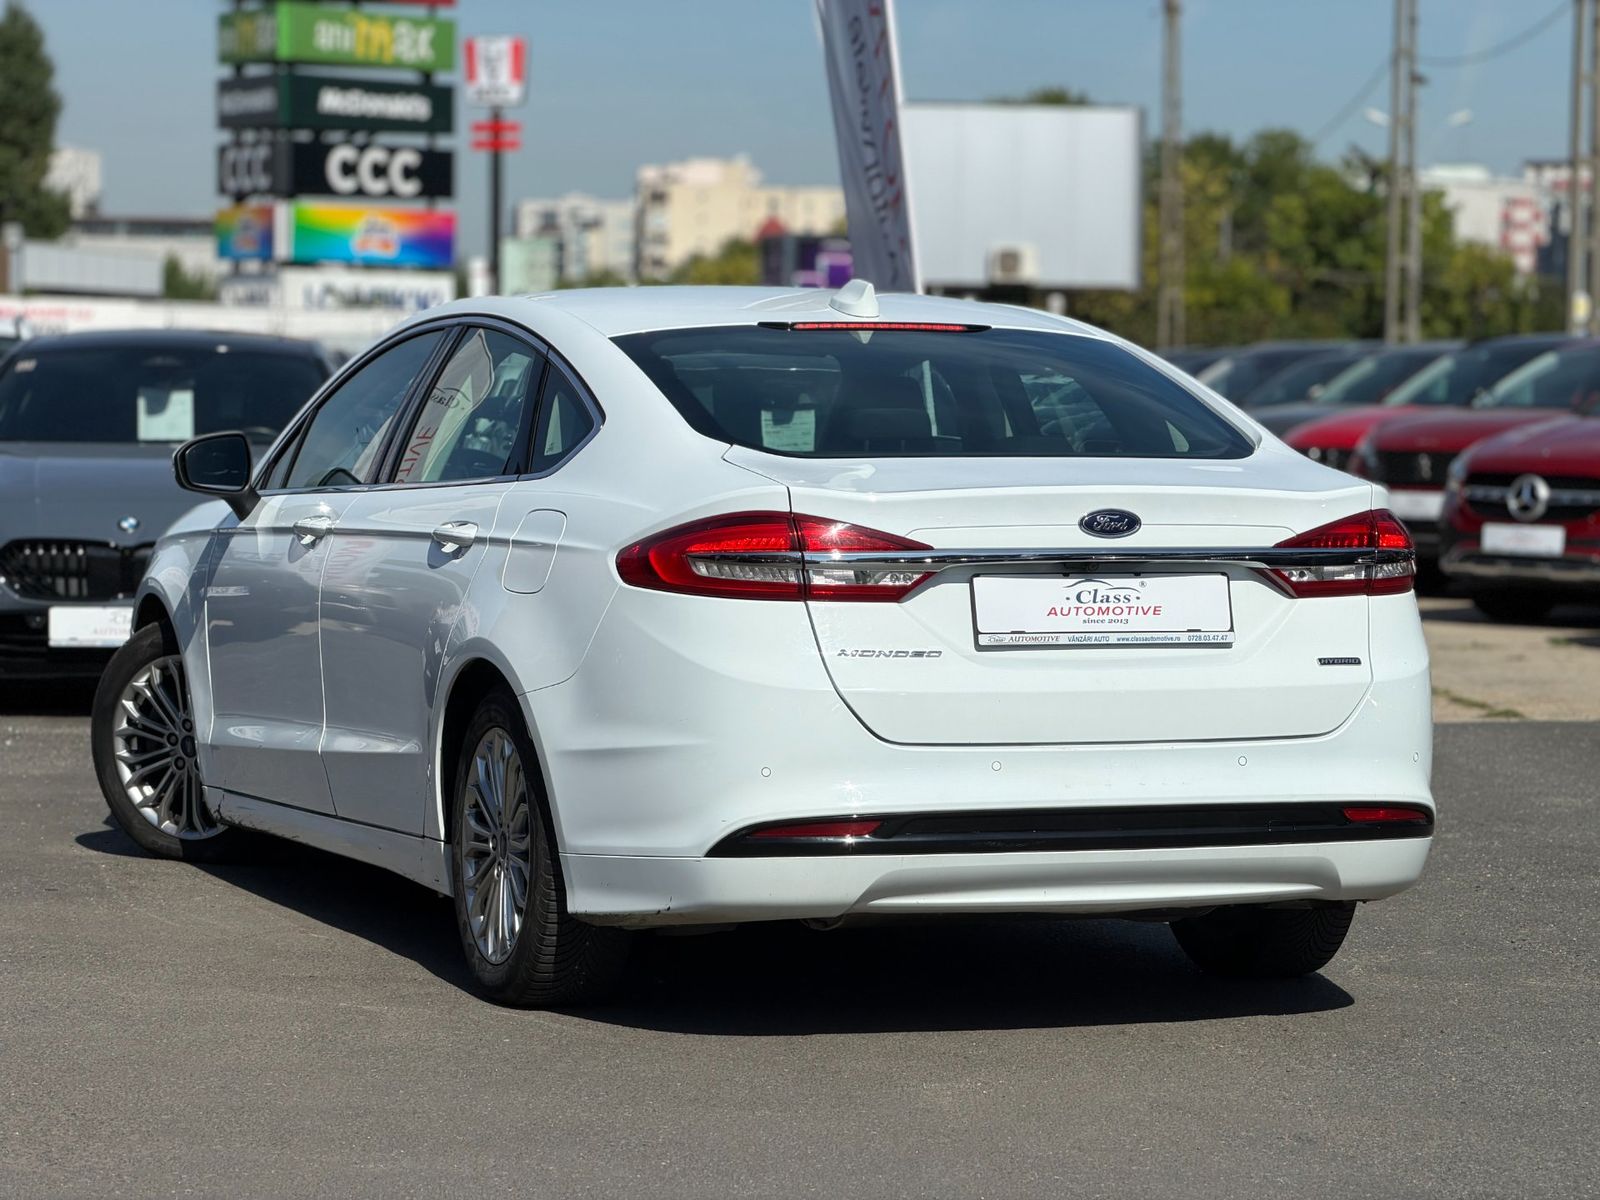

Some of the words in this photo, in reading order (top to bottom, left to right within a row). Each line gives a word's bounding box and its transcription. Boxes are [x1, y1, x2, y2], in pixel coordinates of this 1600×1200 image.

[325, 144, 423, 197] CCC
[1093, 514, 1128, 531] Ford
[1075, 588, 1132, 604] Class
[1046, 605, 1162, 616] AUTOMOTIVE
[1082, 617, 1106, 625] since
